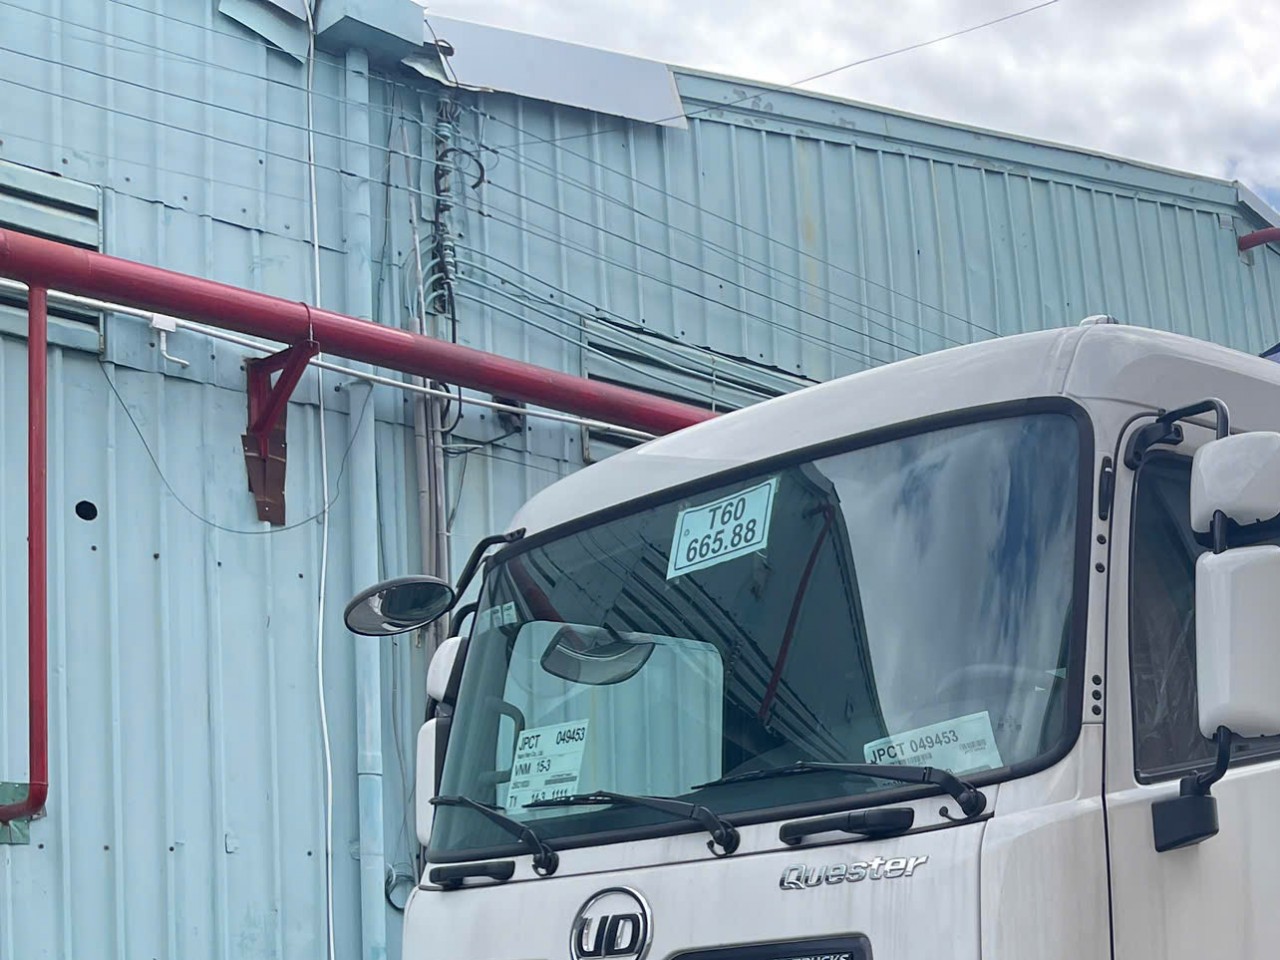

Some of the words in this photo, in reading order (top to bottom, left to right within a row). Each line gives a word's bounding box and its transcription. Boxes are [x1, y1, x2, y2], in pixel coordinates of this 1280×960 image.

[709, 497, 746, 530] T60
[686, 518, 757, 562] 665.88
[519, 735, 541, 750] JPCT
[556, 727, 585, 744] 049453
[870, 742, 905, 764] JPCT
[909, 729, 959, 753] 049453
[778, 854, 930, 891] Quester
[576, 912, 642, 958] UD
